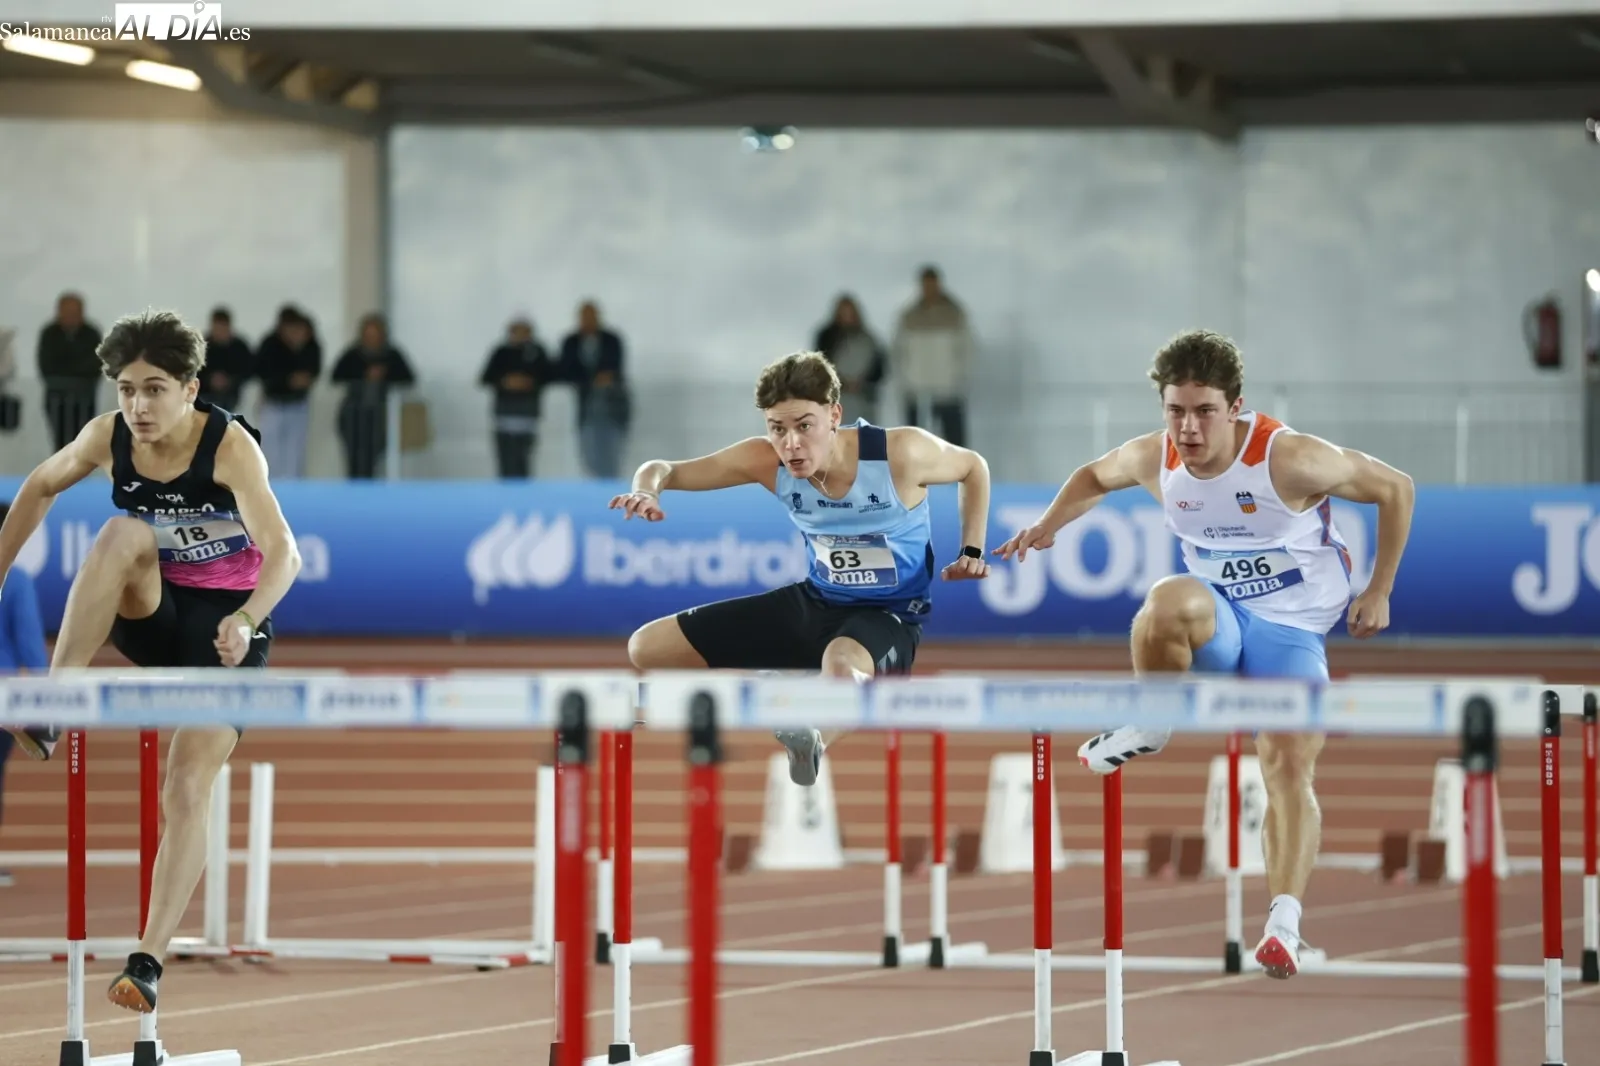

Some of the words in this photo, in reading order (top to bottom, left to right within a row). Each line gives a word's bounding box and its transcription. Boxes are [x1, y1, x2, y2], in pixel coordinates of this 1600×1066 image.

[173, 526, 209, 546] 18
[171, 541, 230, 563] Joma
[584, 526, 809, 589] Iberdrol
[829, 550, 862, 570] 63
[1220, 556, 1272, 581] 496
[1224, 577, 1284, 601] Joma
